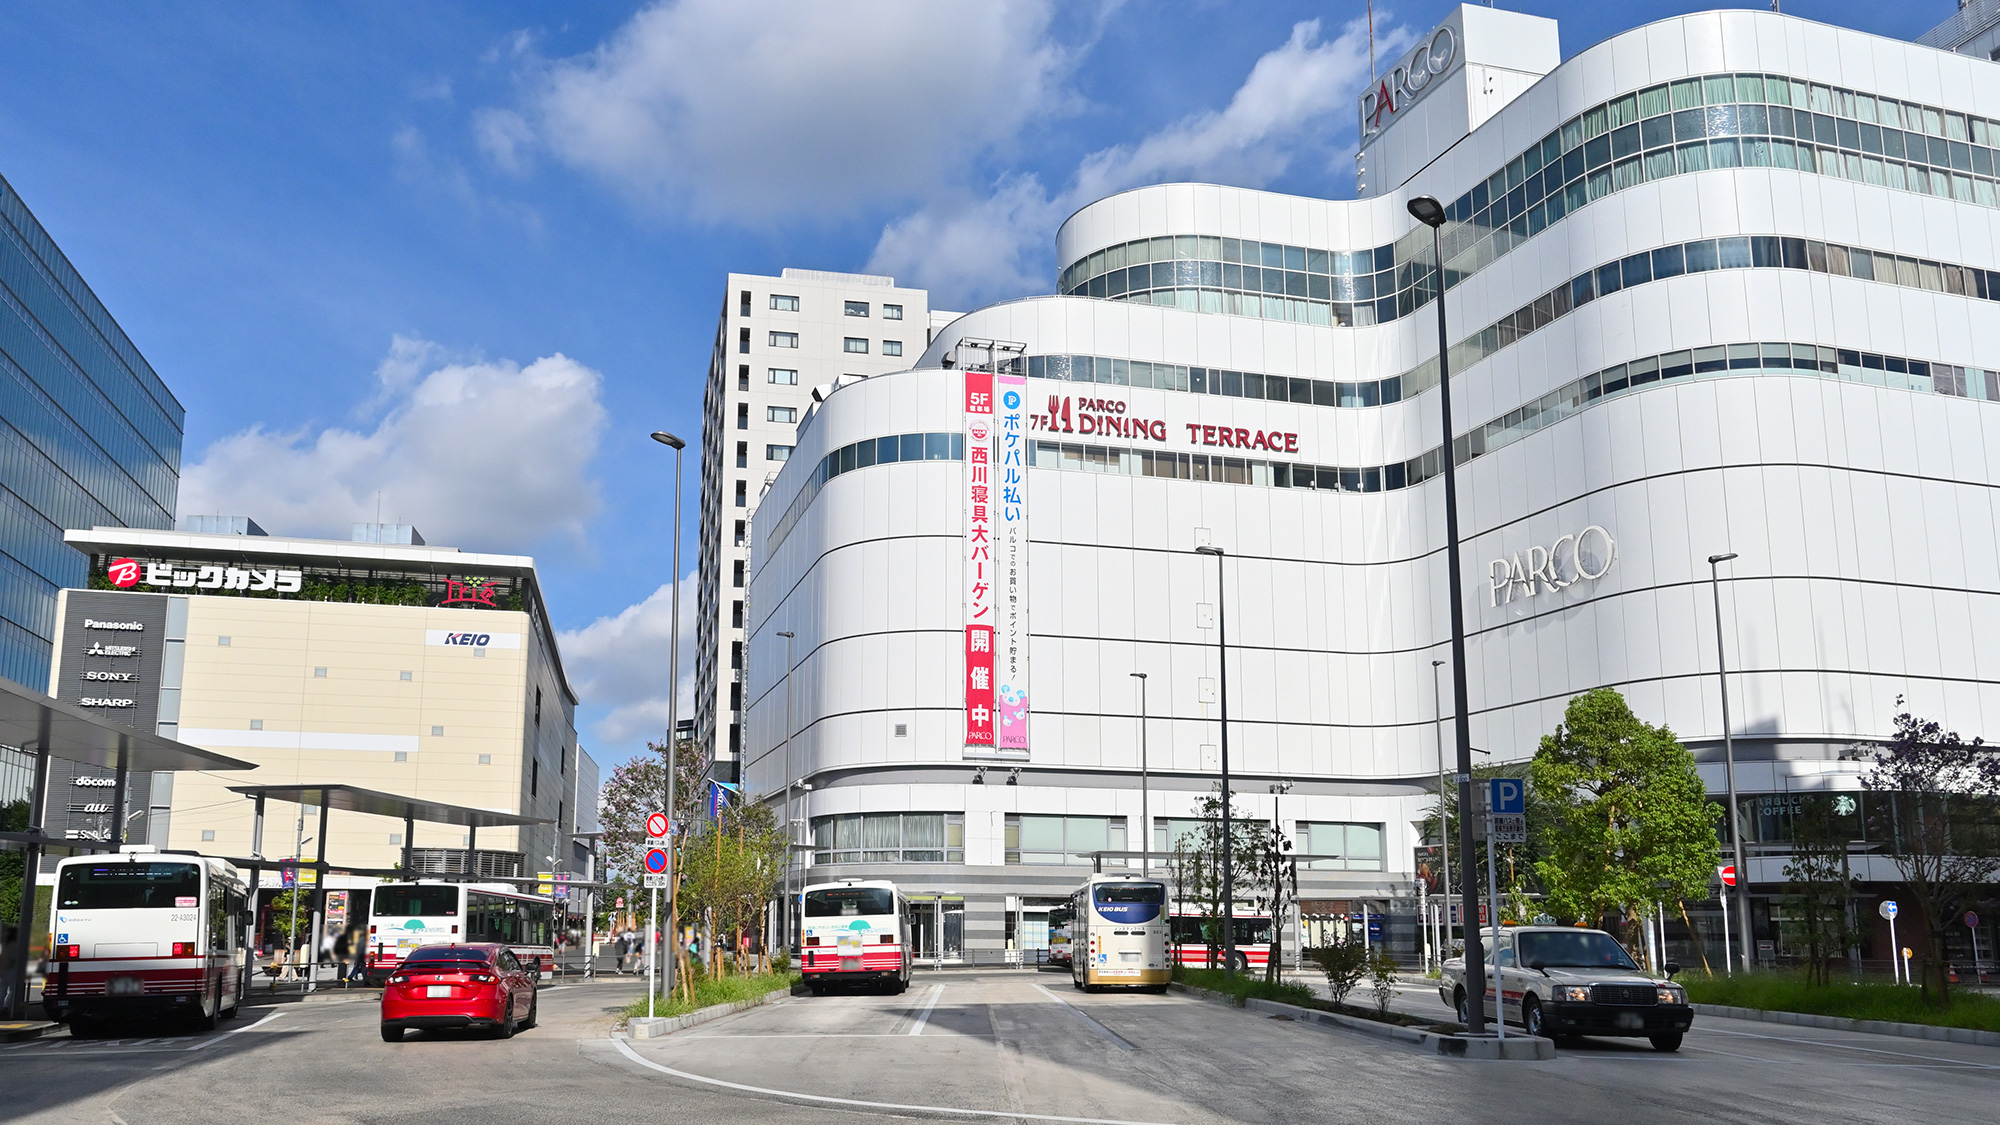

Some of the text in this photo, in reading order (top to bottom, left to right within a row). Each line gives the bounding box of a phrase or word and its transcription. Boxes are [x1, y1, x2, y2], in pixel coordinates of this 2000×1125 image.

[1361, 26, 1457, 137] PARCO
[970, 392, 989, 405] 5F
[1079, 397, 1127, 413] PARCO
[1030, 414, 1048, 430] 7F
[1079, 413, 1299, 453] DINING TERRACE
[1003, 413, 1021, 522] ポケパル払い
[971, 446, 989, 620] 西川寝具大バーゲン
[1488, 525, 1614, 608] PARCO
[147, 563, 302, 593] ビックカメラ
[84, 619, 144, 631] Panasonic
[444, 632, 490, 647] KEIO
[86, 671, 132, 681] SONY
[970, 629, 990, 727] 開催中
[81, 697, 133, 707] SHARP
[968, 732, 992, 740] PARCO
[1003, 735, 1026, 744] PARCO
[76, 776, 116, 787] docom
[1500, 782, 1518, 810] P
[84, 803, 109, 813] au
